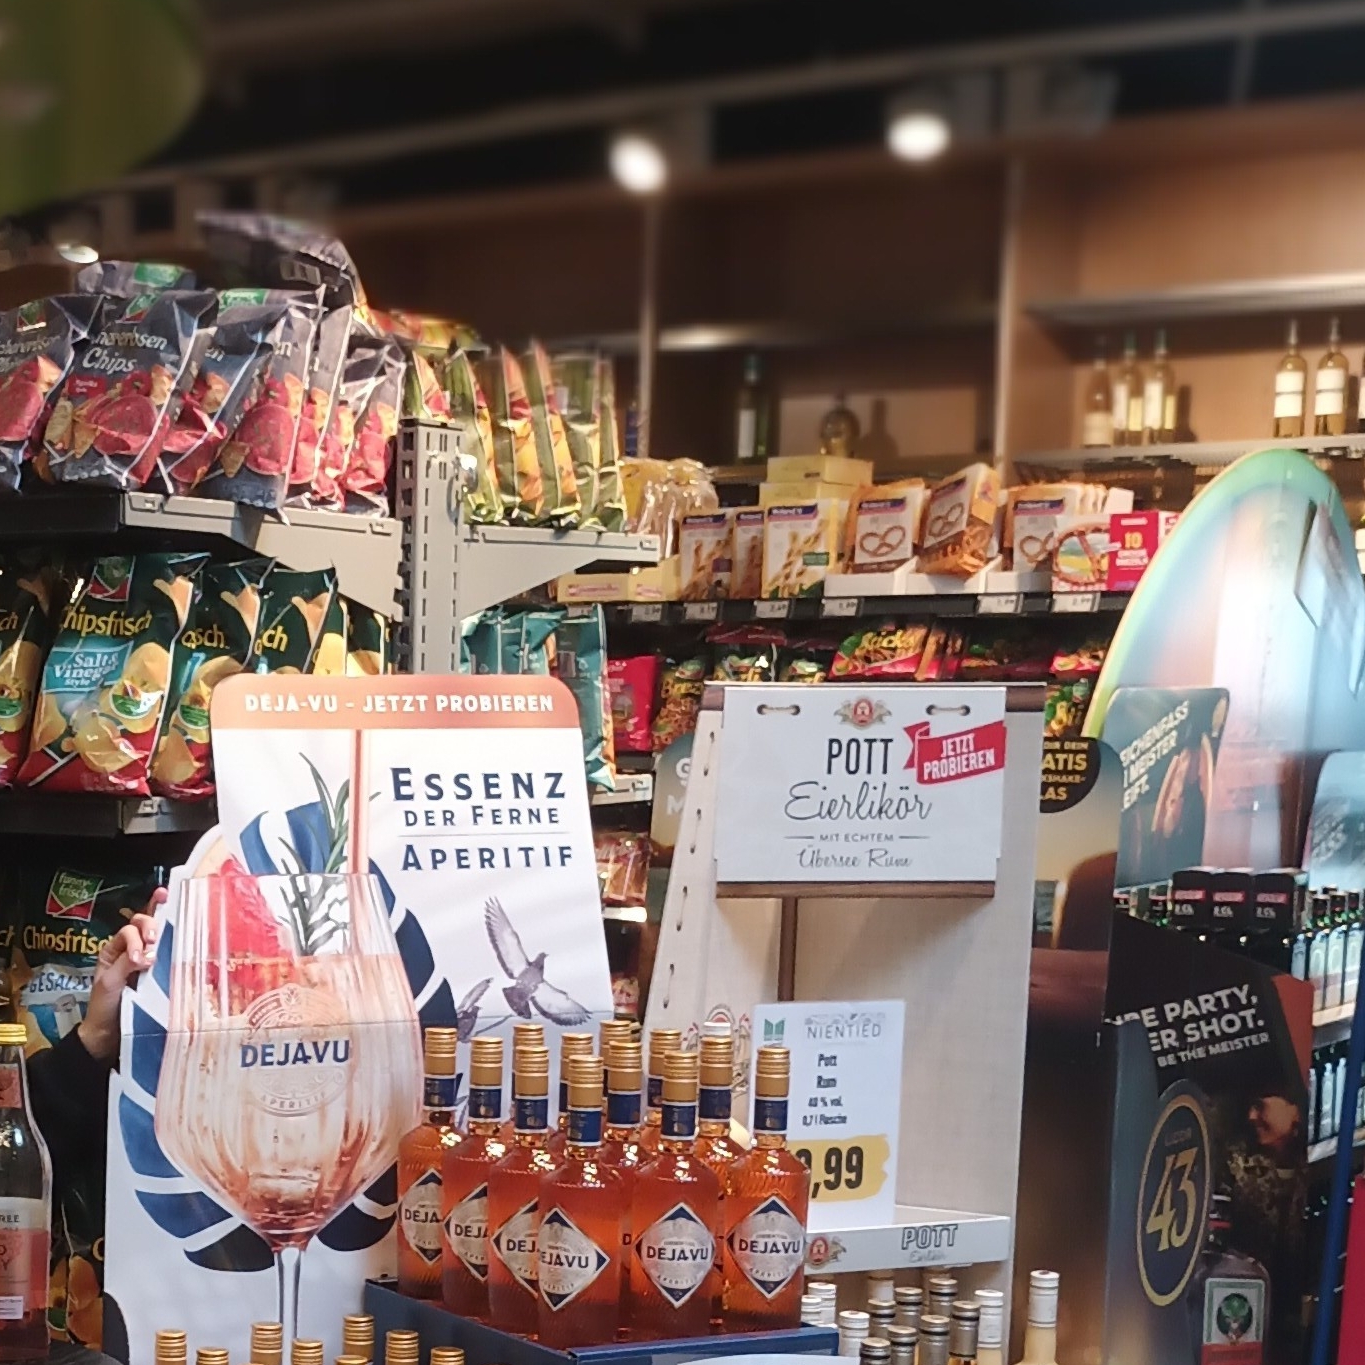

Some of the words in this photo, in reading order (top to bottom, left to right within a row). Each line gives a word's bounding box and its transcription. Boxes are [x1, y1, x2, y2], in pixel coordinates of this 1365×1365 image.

[82, 347, 138, 375] Chips
[53, 662, 118, 682] Vinegar
[362, 694, 428, 714] JETZT
[436, 693, 554, 713] PROBIEREN
[826, 738, 895, 775] POTT
[940, 733, 976, 758] JETZT
[923, 747, 996, 781] PROBIEREN
[1041, 753, 1088, 771] ATIS
[390, 766, 567, 802] ESSENZ
[784, 780, 933, 821] Eierlikör
[404, 807, 456, 828] DER
[472, 804, 560, 826] FERNE
[819, 833, 840, 842] MIT
[844, 832, 895, 842] ECHTEM
[401, 844, 574, 872] APERITIF
[797, 844, 862, 869] Übersee
[867, 848, 914, 869] Rum
[58, 886, 90, 900] frisch
[23, 926, 114, 955] Chipsfrisc
[1163, 984, 1259, 1024] PARTY.
[807, 1023, 883, 1040] NIENTIED
[1183, 1008, 1265, 1044] SHOT.
[817, 1053, 838, 1068] Pott
[1157, 1055, 1176, 1068] BE
[1179, 1047, 1207, 1063] THE
[1208, 1032, 1271, 1056] MEISTER
[816, 1075, 838, 1089] Rum
[1145, 1146, 1200, 1254] 43
[900, 1223, 959, 1251] POTT
